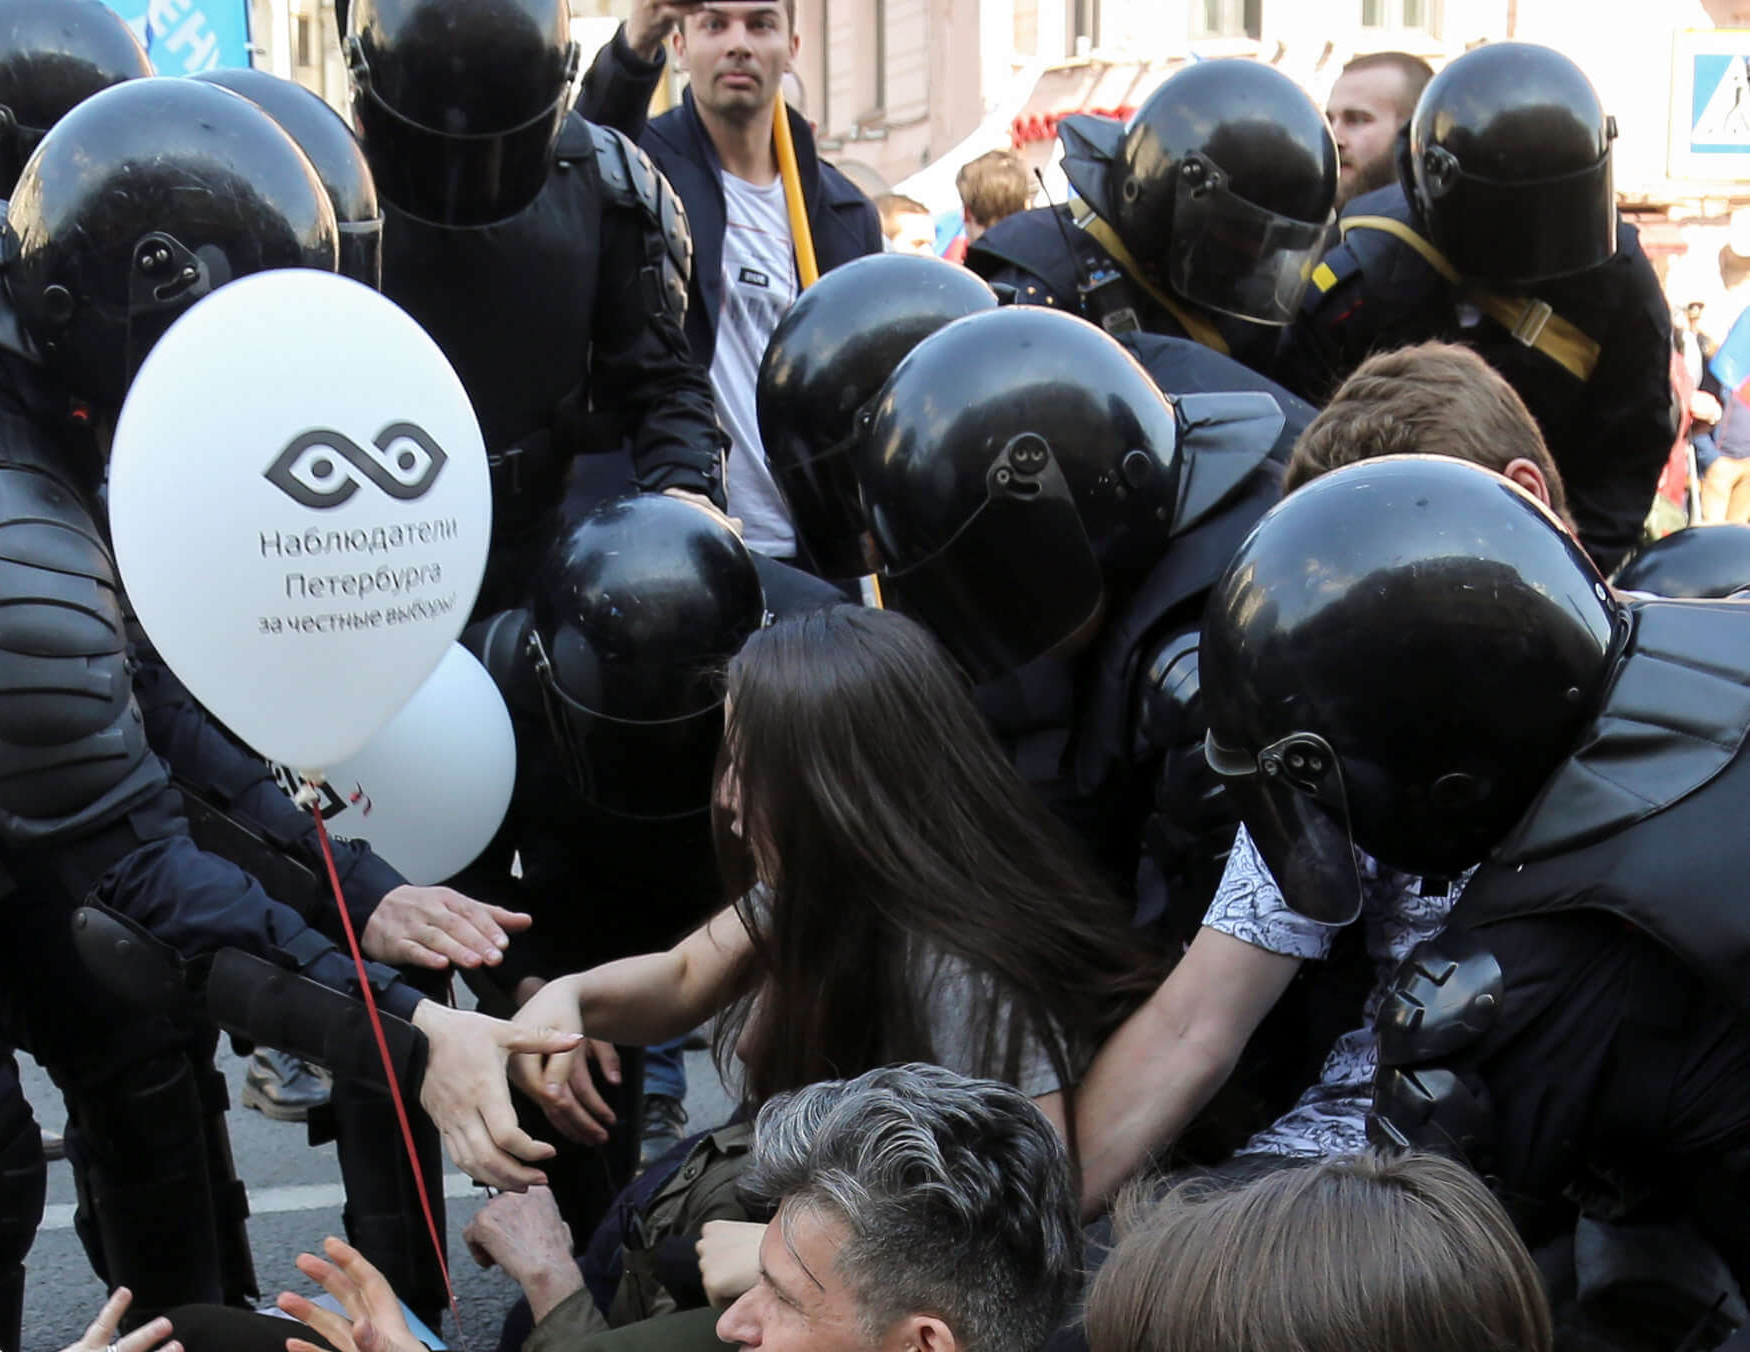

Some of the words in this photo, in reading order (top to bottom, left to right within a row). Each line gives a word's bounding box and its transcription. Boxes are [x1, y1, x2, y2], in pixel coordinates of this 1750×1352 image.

[259, 517, 458, 559] Наблюдатели
[285, 562, 442, 600] Петербурга
[257, 615, 283, 635] за
